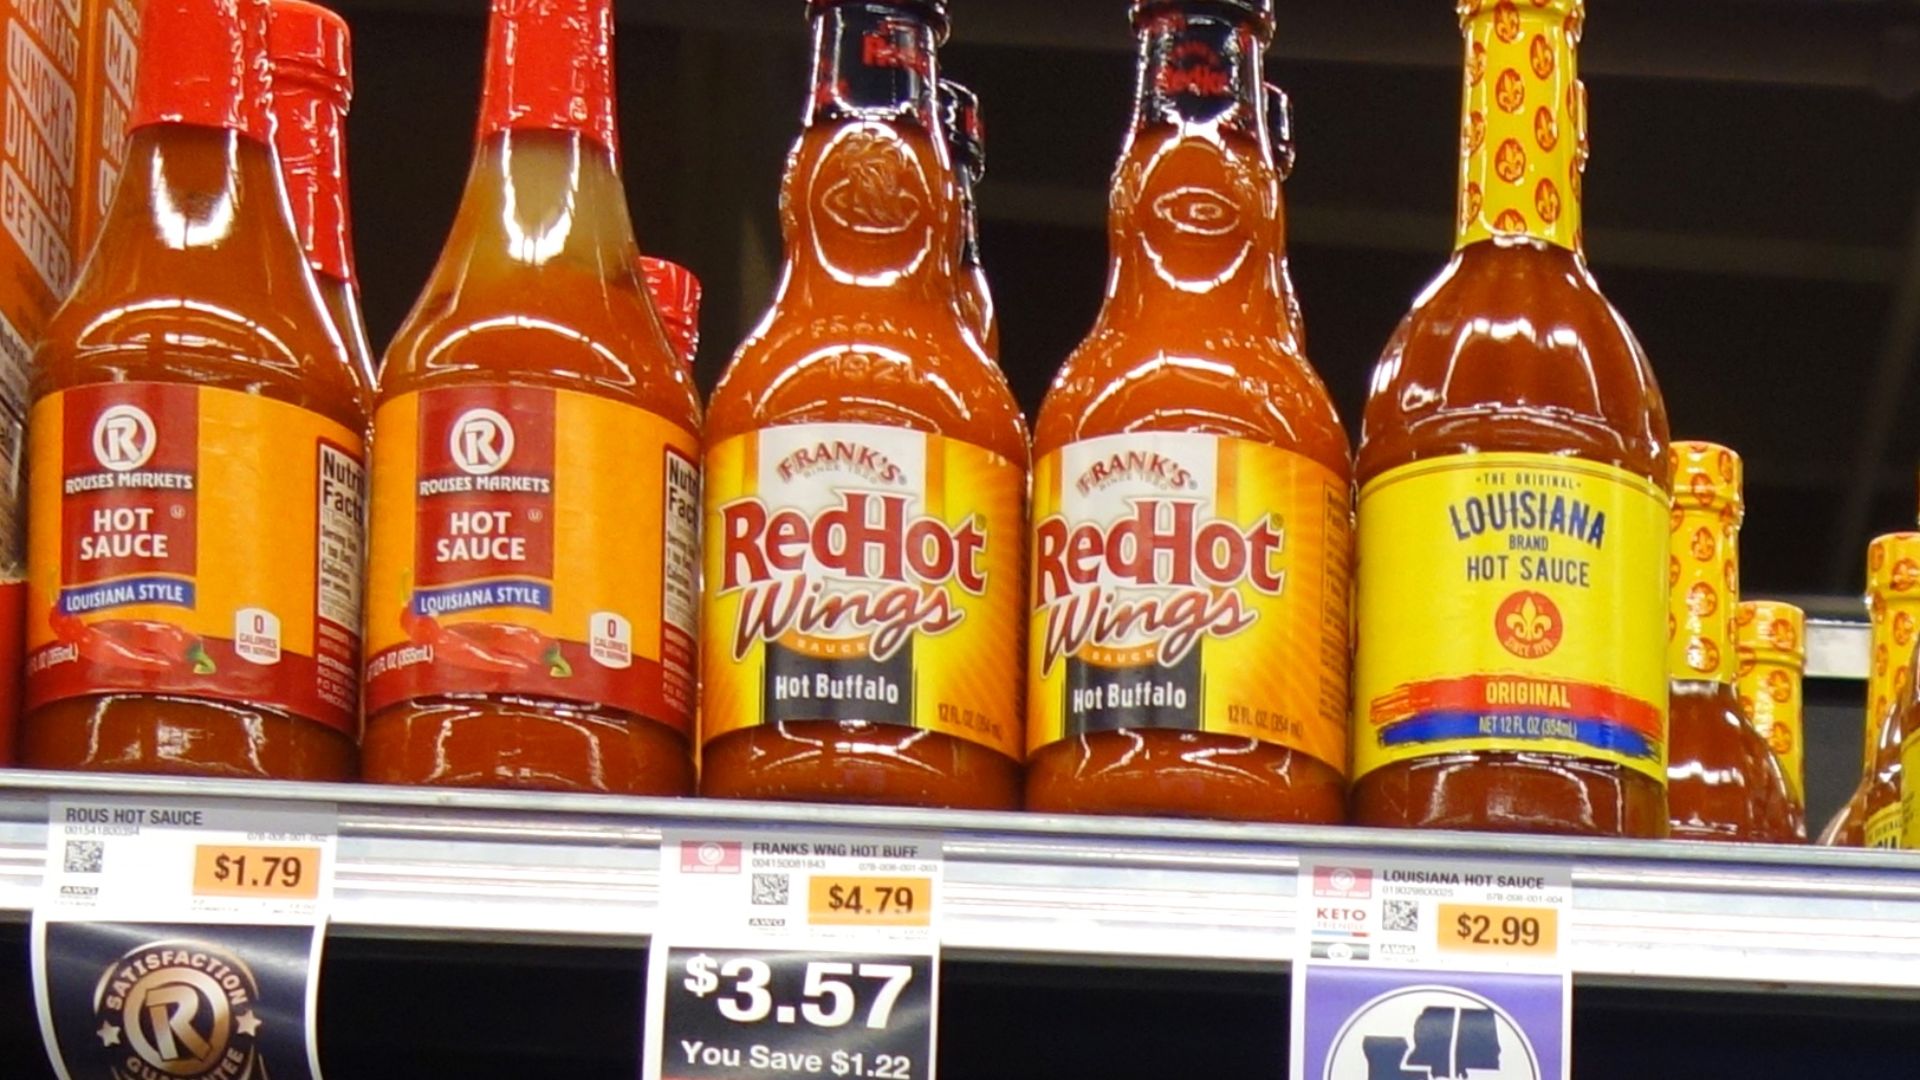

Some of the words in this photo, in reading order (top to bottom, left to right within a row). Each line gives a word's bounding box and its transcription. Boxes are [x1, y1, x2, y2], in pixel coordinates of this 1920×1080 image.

[11, 29, 61, 150] LUNCH
[5, 83, 71, 245] DINNER
[6, 178, 68, 295] BETTER
[777, 440, 902, 484] FRANK'S
[1076, 450, 1191, 497] FRANK'S
[66, 474, 114, 494] ROUSES
[118, 472, 193, 490] MARKETS
[420, 476, 472, 496] ROUSES
[476, 475, 551, 494] MARKETS
[93, 507, 155, 533] HOT
[451, 511, 512, 536] HOT
[1449, 491, 1606, 550] LOUISIANA
[80, 534, 168, 560] SAUCE
[436, 537, 526, 562] SAUCE
[1509, 534, 1549, 551] BRAND
[1467, 556, 1509, 582] HOT
[1520, 556, 1590, 588] SAUCE
[66, 586, 136, 612] LOUISIANA
[138, 584, 183, 603] STYLE
[421, 589, 494, 613] LOUISIANA
[497, 587, 541, 606] STYLE
[734, 575, 964, 661] Wings
[1040, 587, 1258, 678] Wings
[239, 633, 277, 648] CALORIES
[594, 637, 628, 654] CALORIES
[775, 675, 810, 701] Hot
[816, 673, 899, 705] Buffalo
[1073, 687, 1103, 713] Hot
[1107, 681, 1187, 709] Buffalo
[1486, 682, 1572, 708] ORIGINAL
[1479, 715, 1498, 734] NET
[1500, 716, 1511, 733] 12
[1513, 716, 1525, 734] FL
[1527, 717, 1540, 734] OZ
[66, 807, 109, 824] ROUS
[114, 809, 145, 824] HOT
[150, 810, 203, 827] SAUCE
[752, 841, 809, 856] FRANKS
[813, 844, 847, 857] WNG
[851, 845, 877, 858] HOT
[883, 845, 919, 859] BUFF
[213, 853, 302, 888] $1.79
[1383, 869, 1459, 886] LOUISIANA
[1464, 873, 1493, 888] HOT
[1497, 875, 1545, 890] SAUCE
[827, 884, 914, 916] $4.79
[1317, 906, 1367, 922] KETO
[1456, 911, 1541, 948] $2.99
[106, 950, 248, 1011] SATISFACTION
[683, 952, 913, 1029] $3.57
[681, 1040, 740, 1067] You
[750, 1044, 822, 1072] Save
[830, 1049, 911, 1080] $1.22
